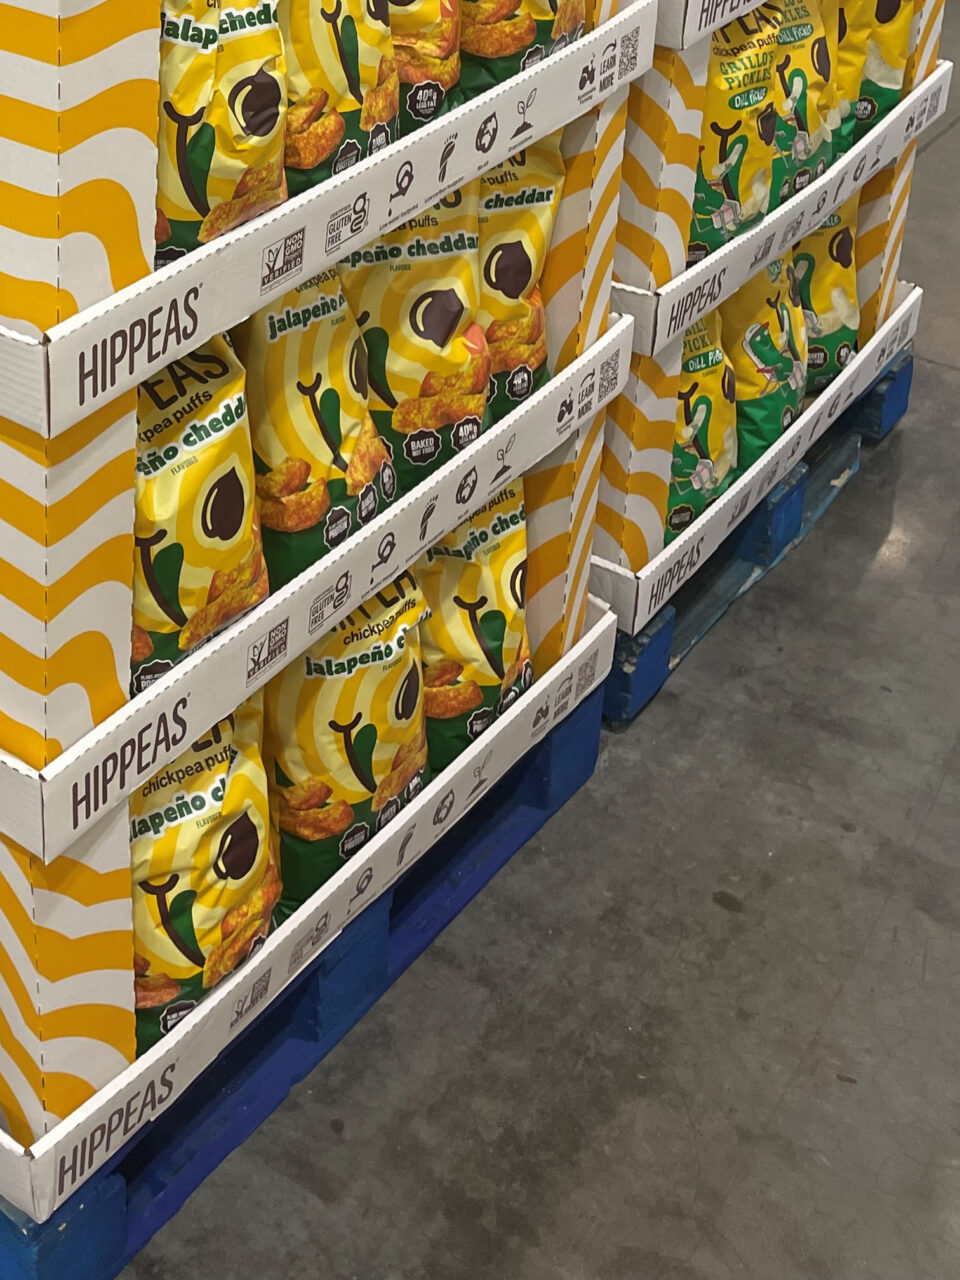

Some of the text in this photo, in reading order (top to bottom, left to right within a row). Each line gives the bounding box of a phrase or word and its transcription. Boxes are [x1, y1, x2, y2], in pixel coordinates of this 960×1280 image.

[599, 54, 617, 75] LEARN
[599, 70, 615, 90] MORE
[484, 186, 554, 210] cheddar
[326, 216, 352, 237] GLUTEN
[284, 242, 304, 258] GMO
[285, 230, 305, 248] NON
[326, 232, 344, 248] FREE
[262, 263, 304, 286] VERIFIED
[668, 266, 727, 337] HIPPEAS
[268, 292, 338, 339] jalapeño
[78, 285, 199, 407] HIPPEAS
[410, 438, 437, 452] BAKED
[647, 535, 704, 616] HIPPEAS
[304, 642, 394, 678] jalapeño
[72, 695, 189, 831] HIPPEAS
[140, 762, 203, 800] chickpea
[57, 1062, 176, 1198] HIPPEAS
